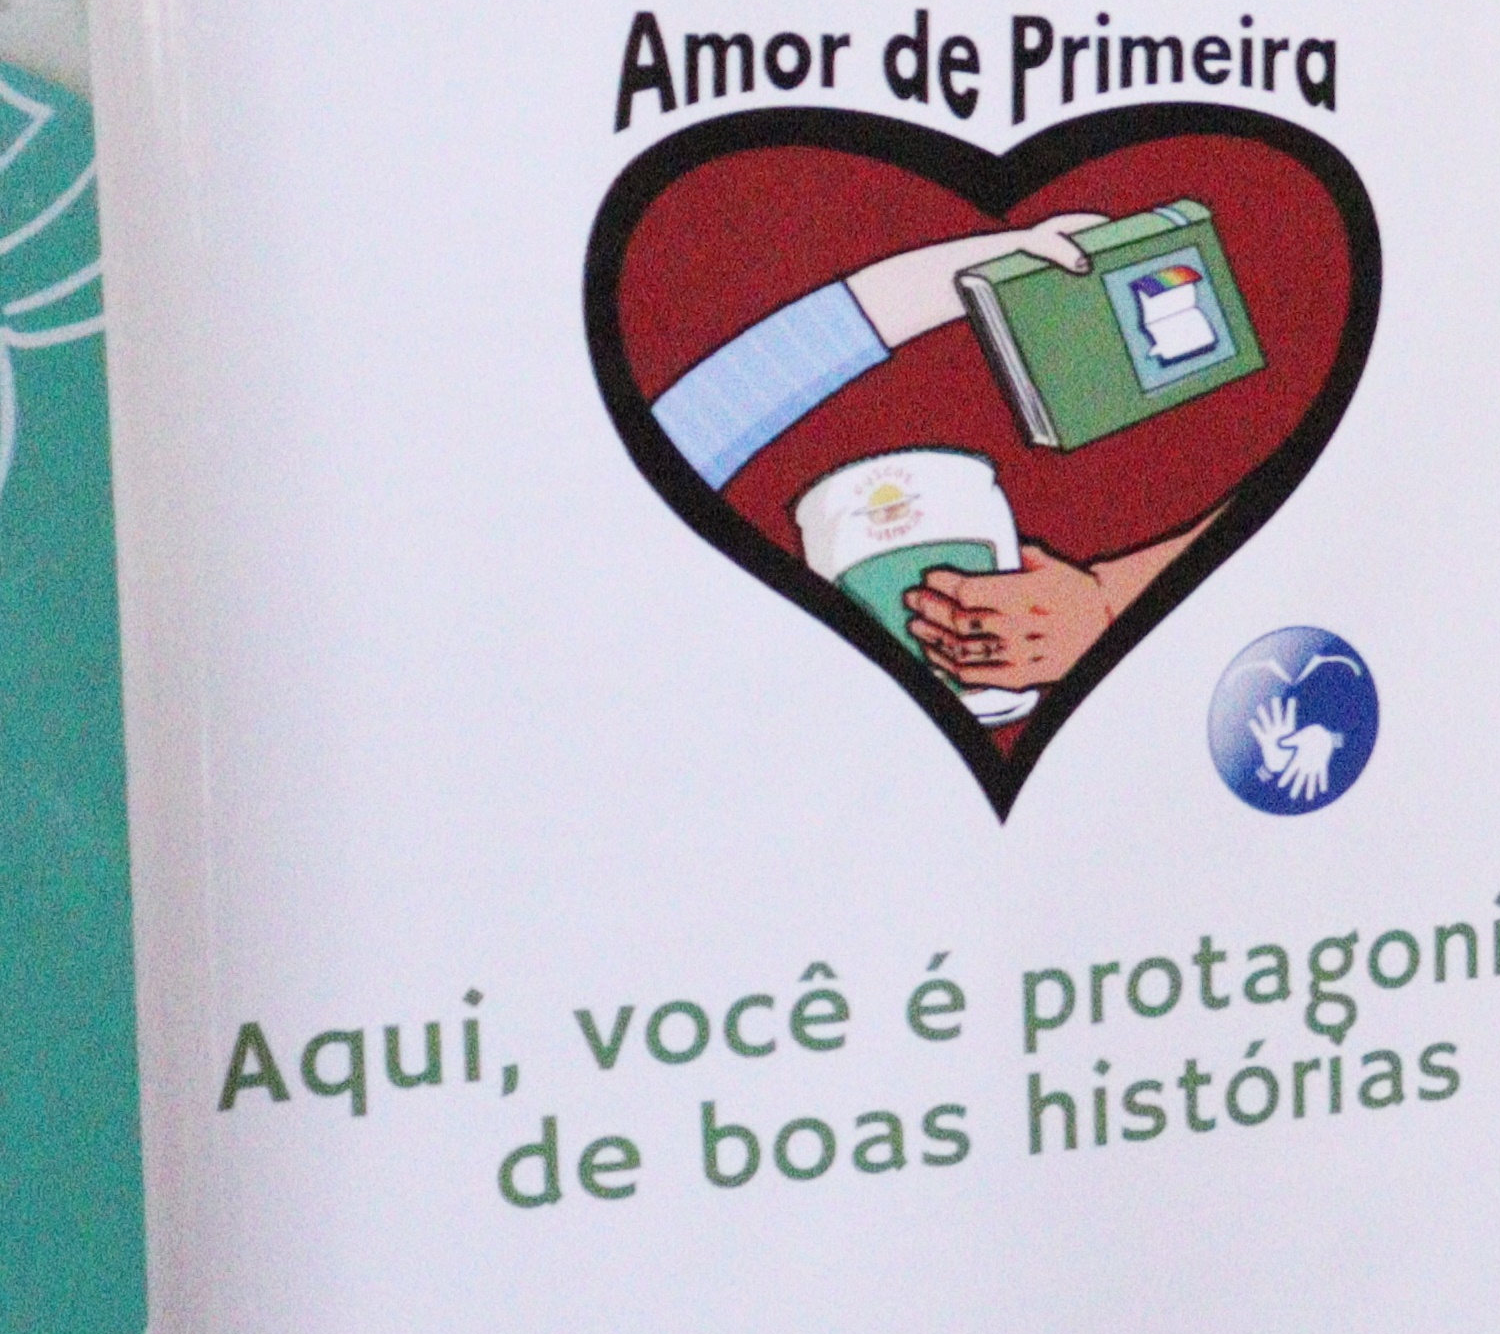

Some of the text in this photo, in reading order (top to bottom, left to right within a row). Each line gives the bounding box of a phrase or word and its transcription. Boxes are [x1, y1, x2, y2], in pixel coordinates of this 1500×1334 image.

[613, 9, 1338, 134] Amor de Primeira
[217, 987, 520, 1118] Aqui,
[573, 960, 852, 1071] você
[905, 951, 967, 1042] é
[497, 1037, 1462, 1209] de boas histórias
